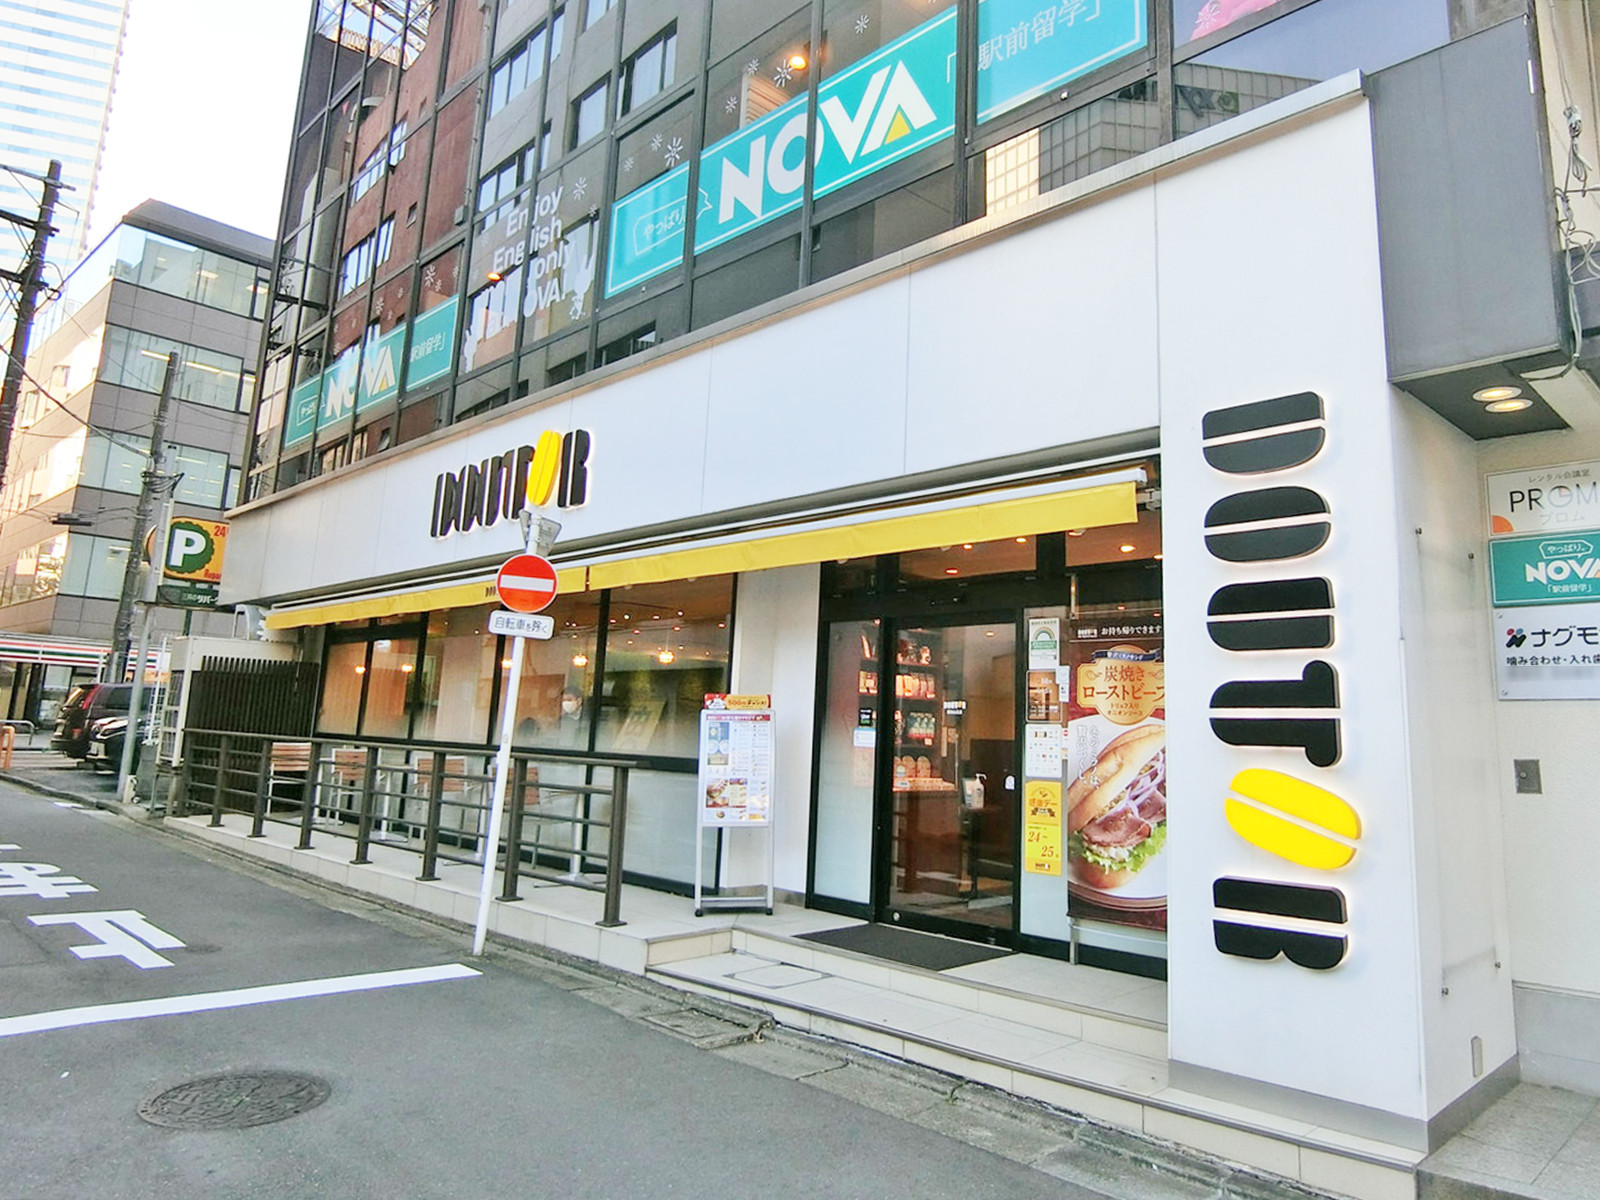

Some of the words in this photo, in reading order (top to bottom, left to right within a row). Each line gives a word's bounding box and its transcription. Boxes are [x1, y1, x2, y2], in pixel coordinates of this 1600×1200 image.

[718, 61, 937, 225] NOVA
[505, 184, 564, 239] Enjoy
[493, 216, 563, 274] English
[430, 429, 591, 538] DOUTOR
[1528, 469, 1591, 483] レンタル会議室
[168, 528, 206, 567] P
[1525, 558, 1600, 585] NOVA
[494, 616, 548, 634] 自転車を除く
[1530, 625, 1600, 648] ナグモ
[1104, 665, 1145, 682] 炭焼き
[1202, 391, 1361, 971] DOUTOR
[1082, 683, 1166, 702] ローストビーフ
